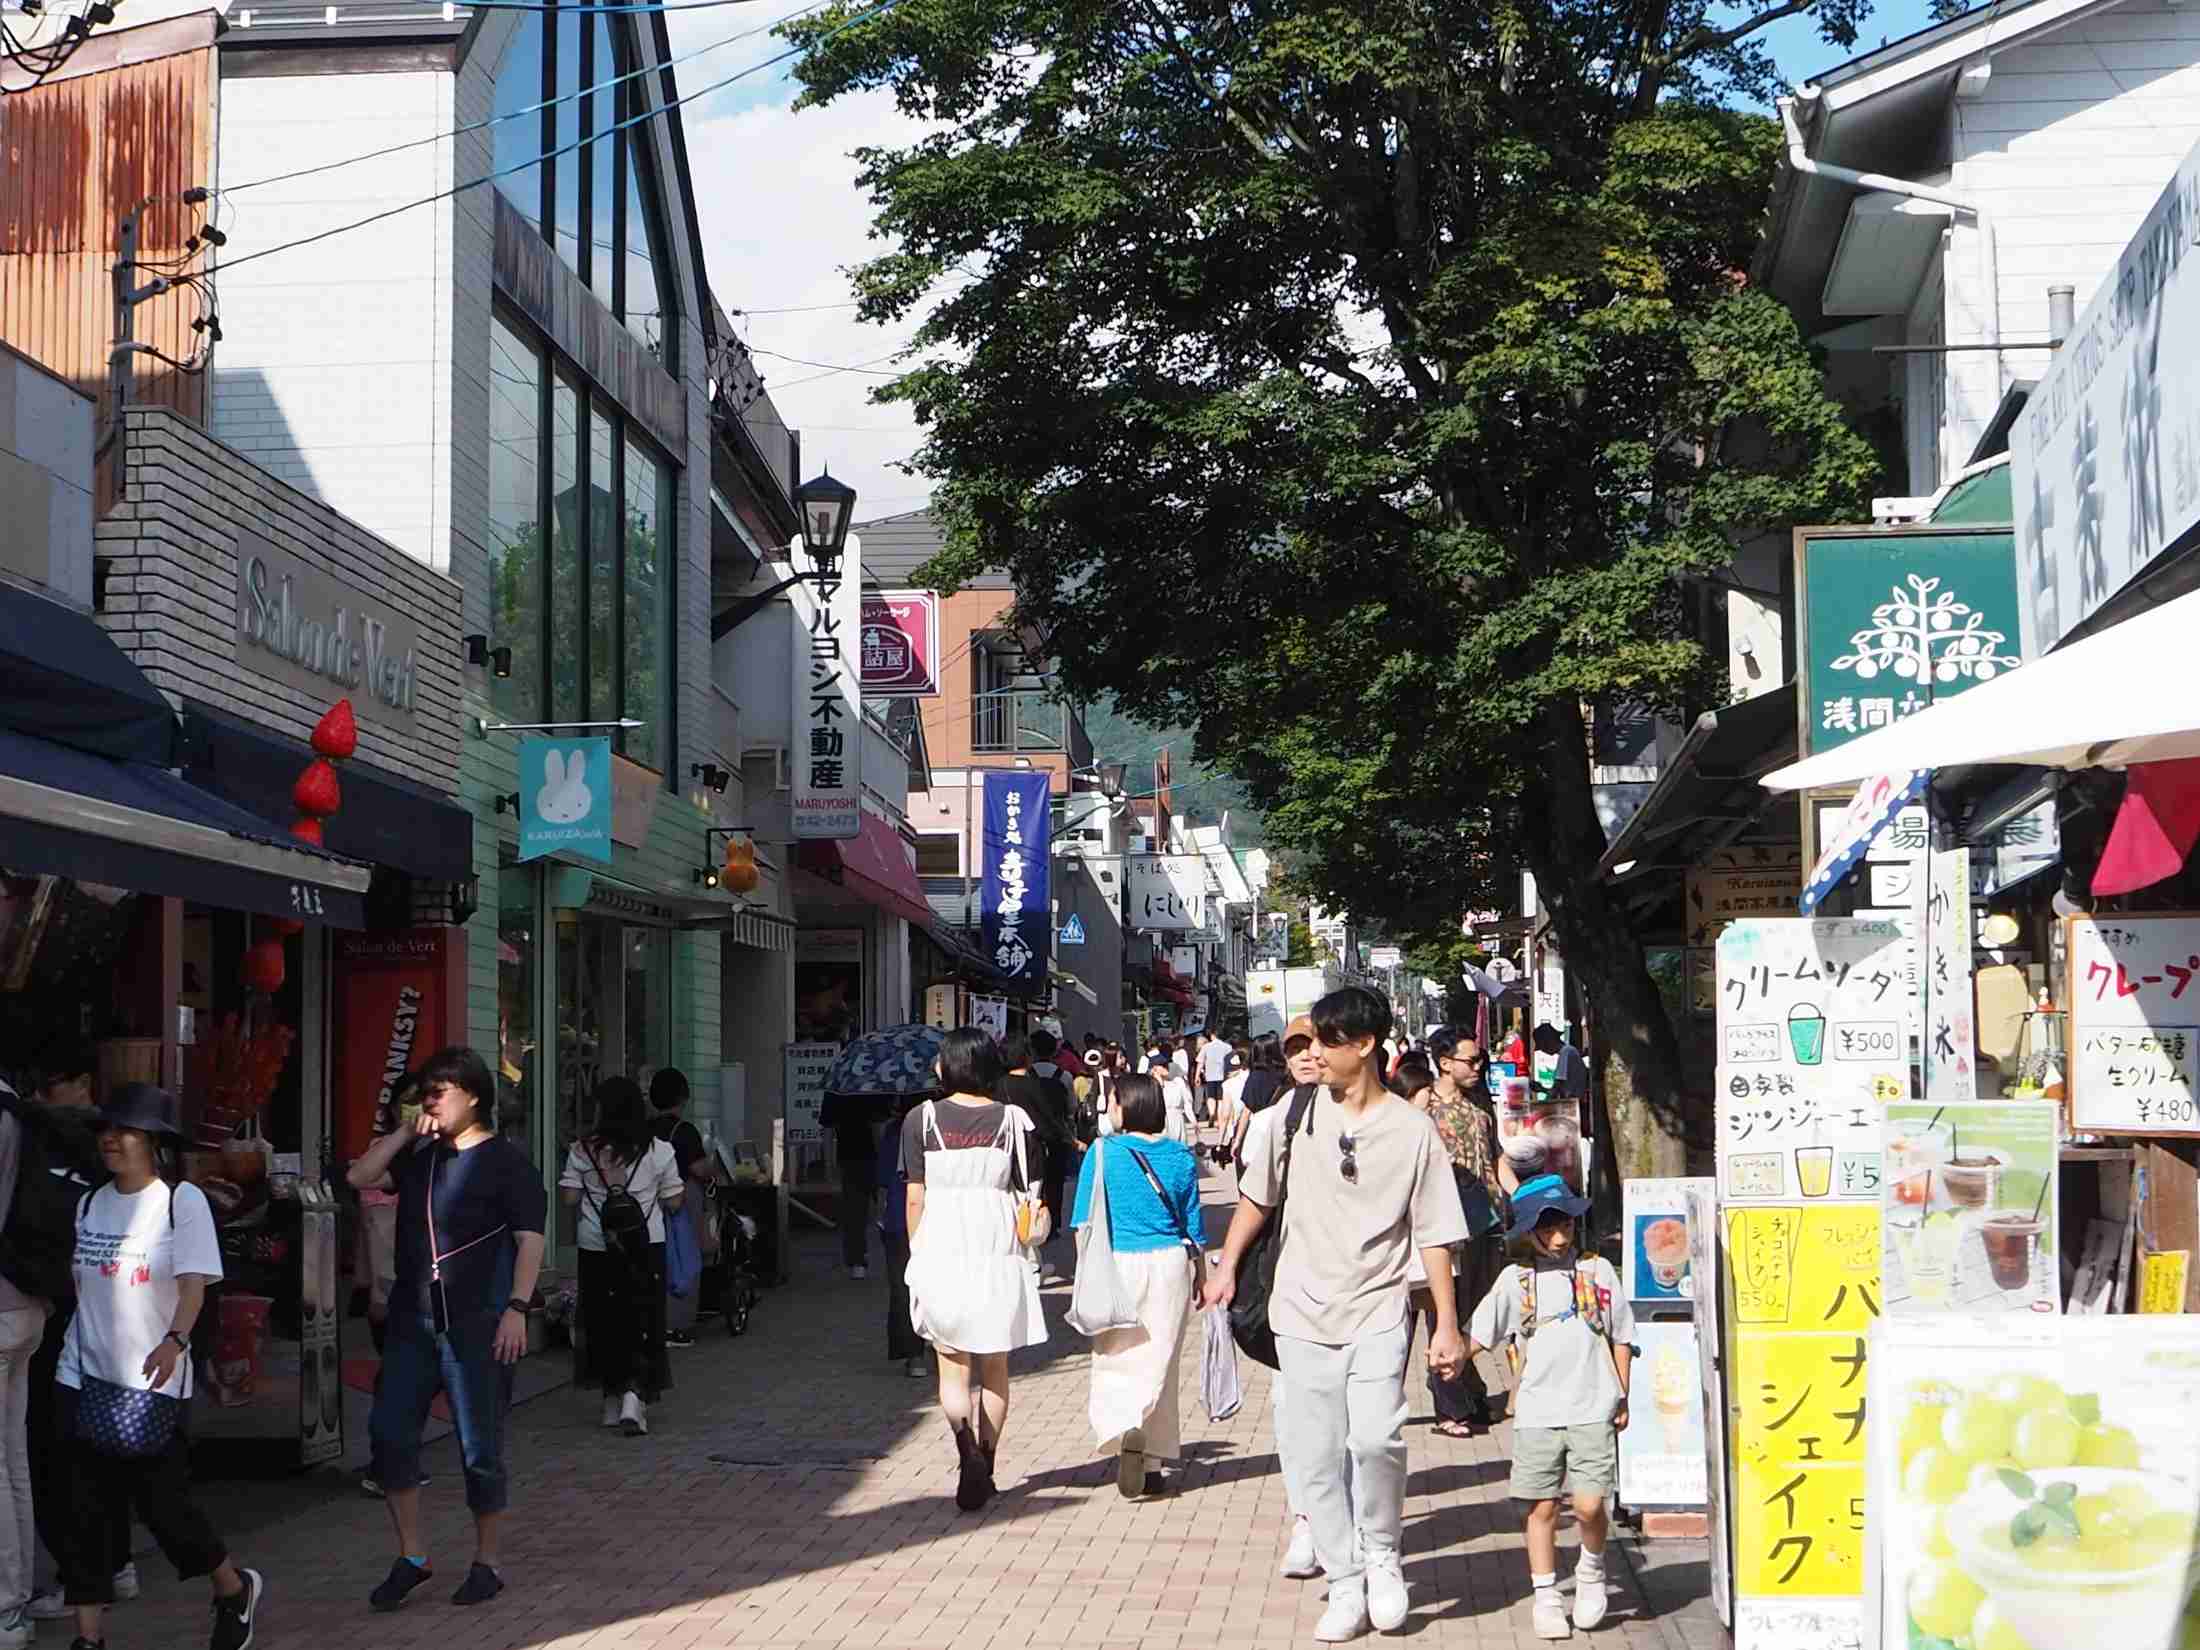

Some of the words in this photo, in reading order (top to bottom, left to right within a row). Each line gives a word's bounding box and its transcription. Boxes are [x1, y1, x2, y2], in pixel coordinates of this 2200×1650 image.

[809, 579, 844, 790] マルヨシ不動産
[795, 798, 857, 810] MARUYOSHI
[1726, 957, 1902, 1012] クリームソーダ
[2087, 955, 2200, 1001] クレープ
[1839, 1030, 1894, 1053] ¥500
[2107, 1066, 2190, 1087] 生クリーム
[2136, 1097, 2193, 1122] ¥480
[1823, 1276, 1881, 1446] バナナ
[1760, 1382, 1824, 1584] シェイク
